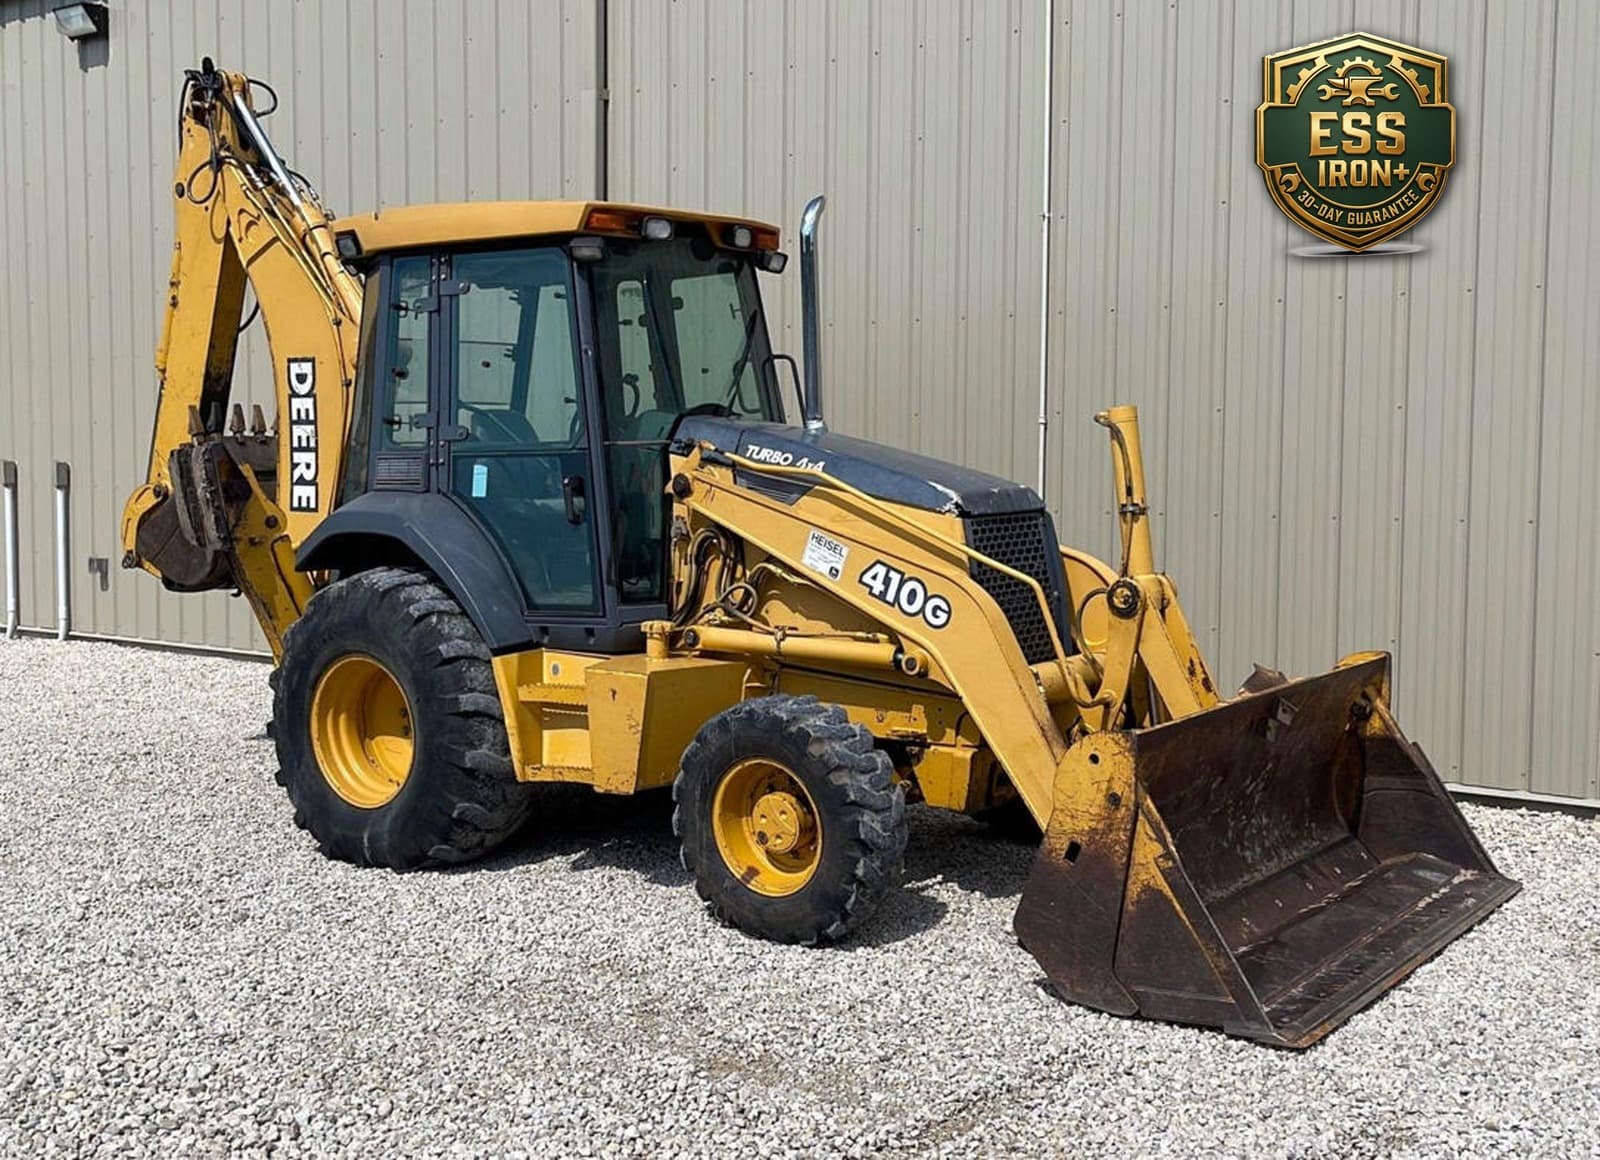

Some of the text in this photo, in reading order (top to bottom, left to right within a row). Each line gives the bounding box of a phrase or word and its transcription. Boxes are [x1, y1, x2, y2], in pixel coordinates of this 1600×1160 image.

[289, 361, 317, 509] DEERE
[746, 444, 793, 465] TURBO
[811, 532, 844, 558] HEISEL
[860, 561, 950, 628] 410G
